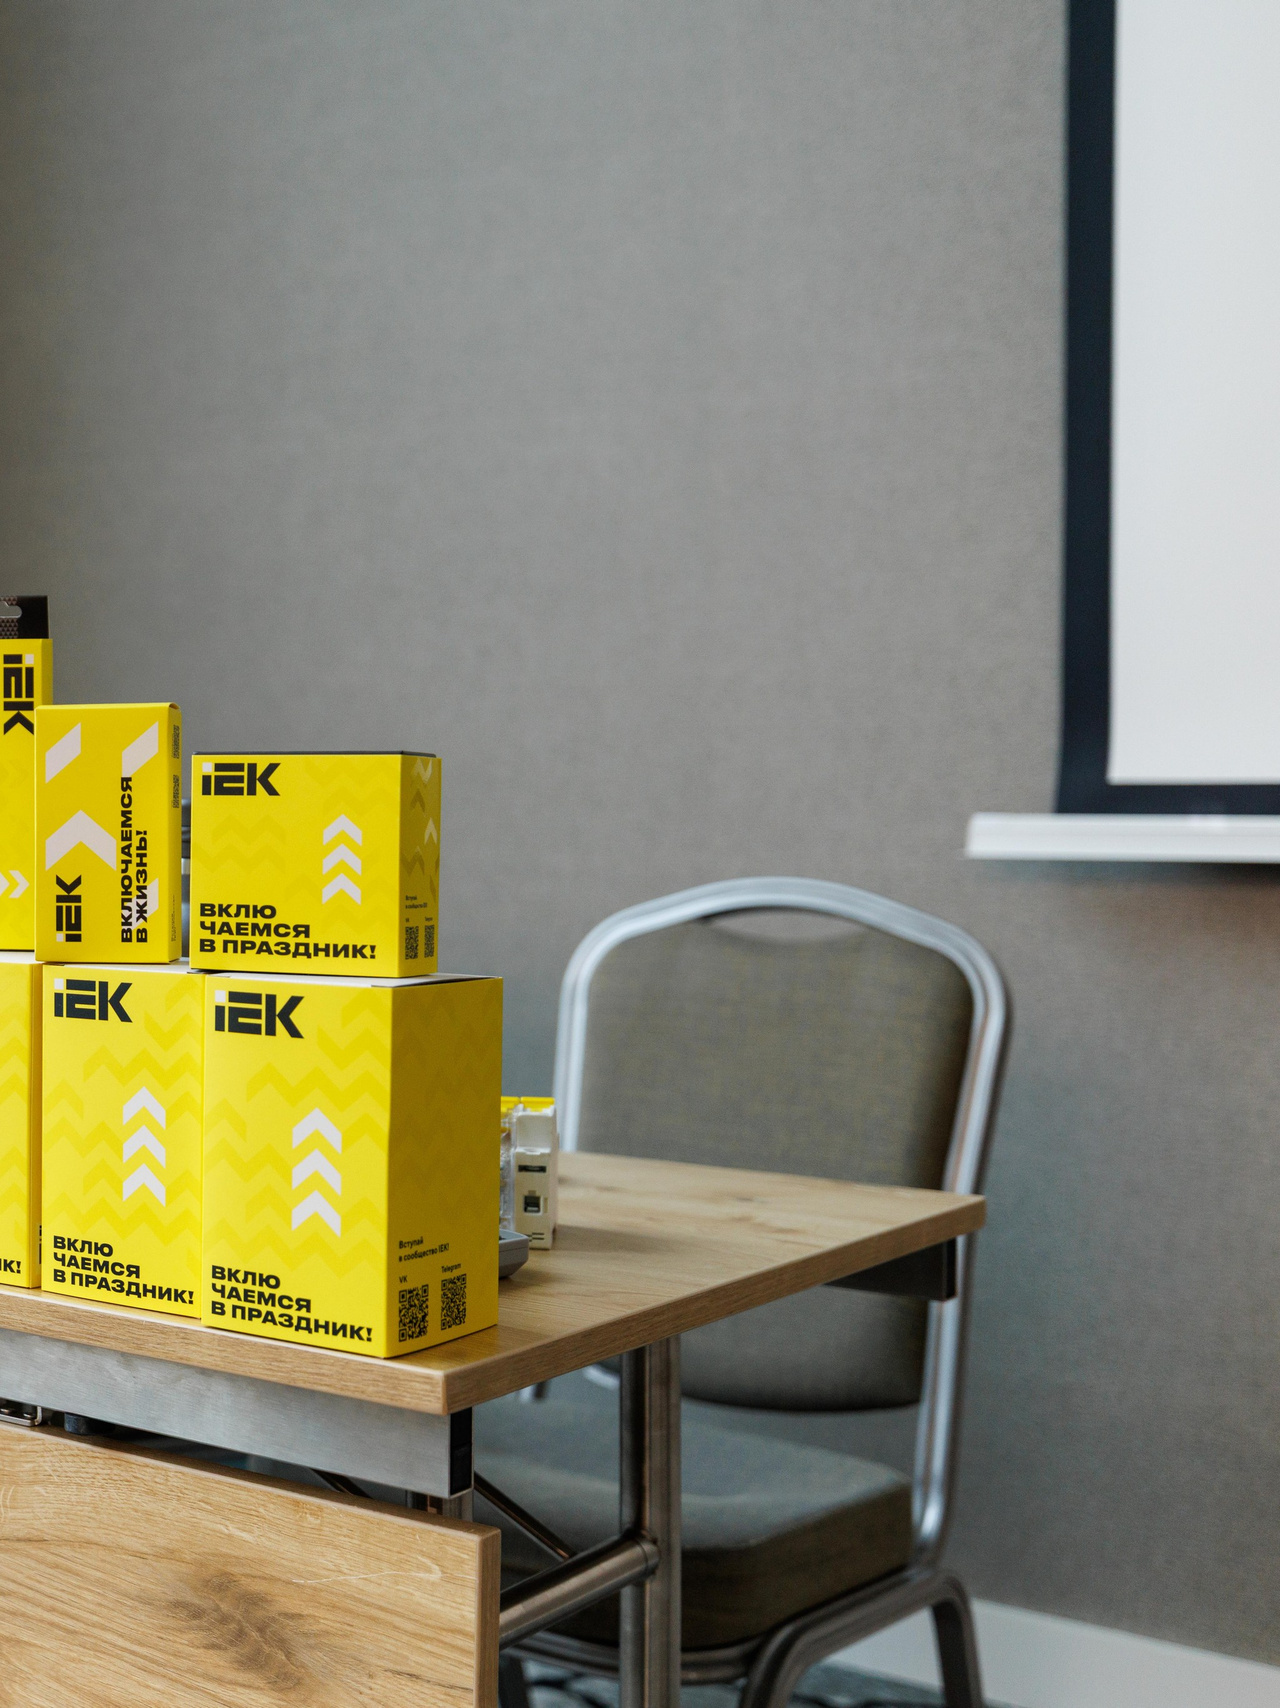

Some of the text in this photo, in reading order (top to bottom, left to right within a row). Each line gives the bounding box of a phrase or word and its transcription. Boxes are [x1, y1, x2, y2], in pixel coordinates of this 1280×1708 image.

[120, 777, 133, 943] ВКЛЮЧАЕМСЯ
[136, 830, 148, 943] В ЖИЗНЬ!
[200, 903, 277, 919] ВКЛЮ
[200, 921, 310, 938] ЧАЕМСЯ
[200, 939, 376, 959] В ПРАЗДНИК!
[53, 1235, 114, 1257] ВКЛЮ
[399, 1236, 424, 1249] Вступай
[404, 1247, 437, 1261] сообщество
[53, 1252, 140, 1279] ЧАЕМСЯ
[211, 1265, 281, 1289] ВКЛЮ
[441, 1263, 461, 1273] Telegram
[53, 1268, 194, 1305] В ПРАЗДНИК!
[211, 1283, 311, 1313] ЧАЕМСЯ
[211, 1301, 372, 1342] В ПРАЗДНИК!
